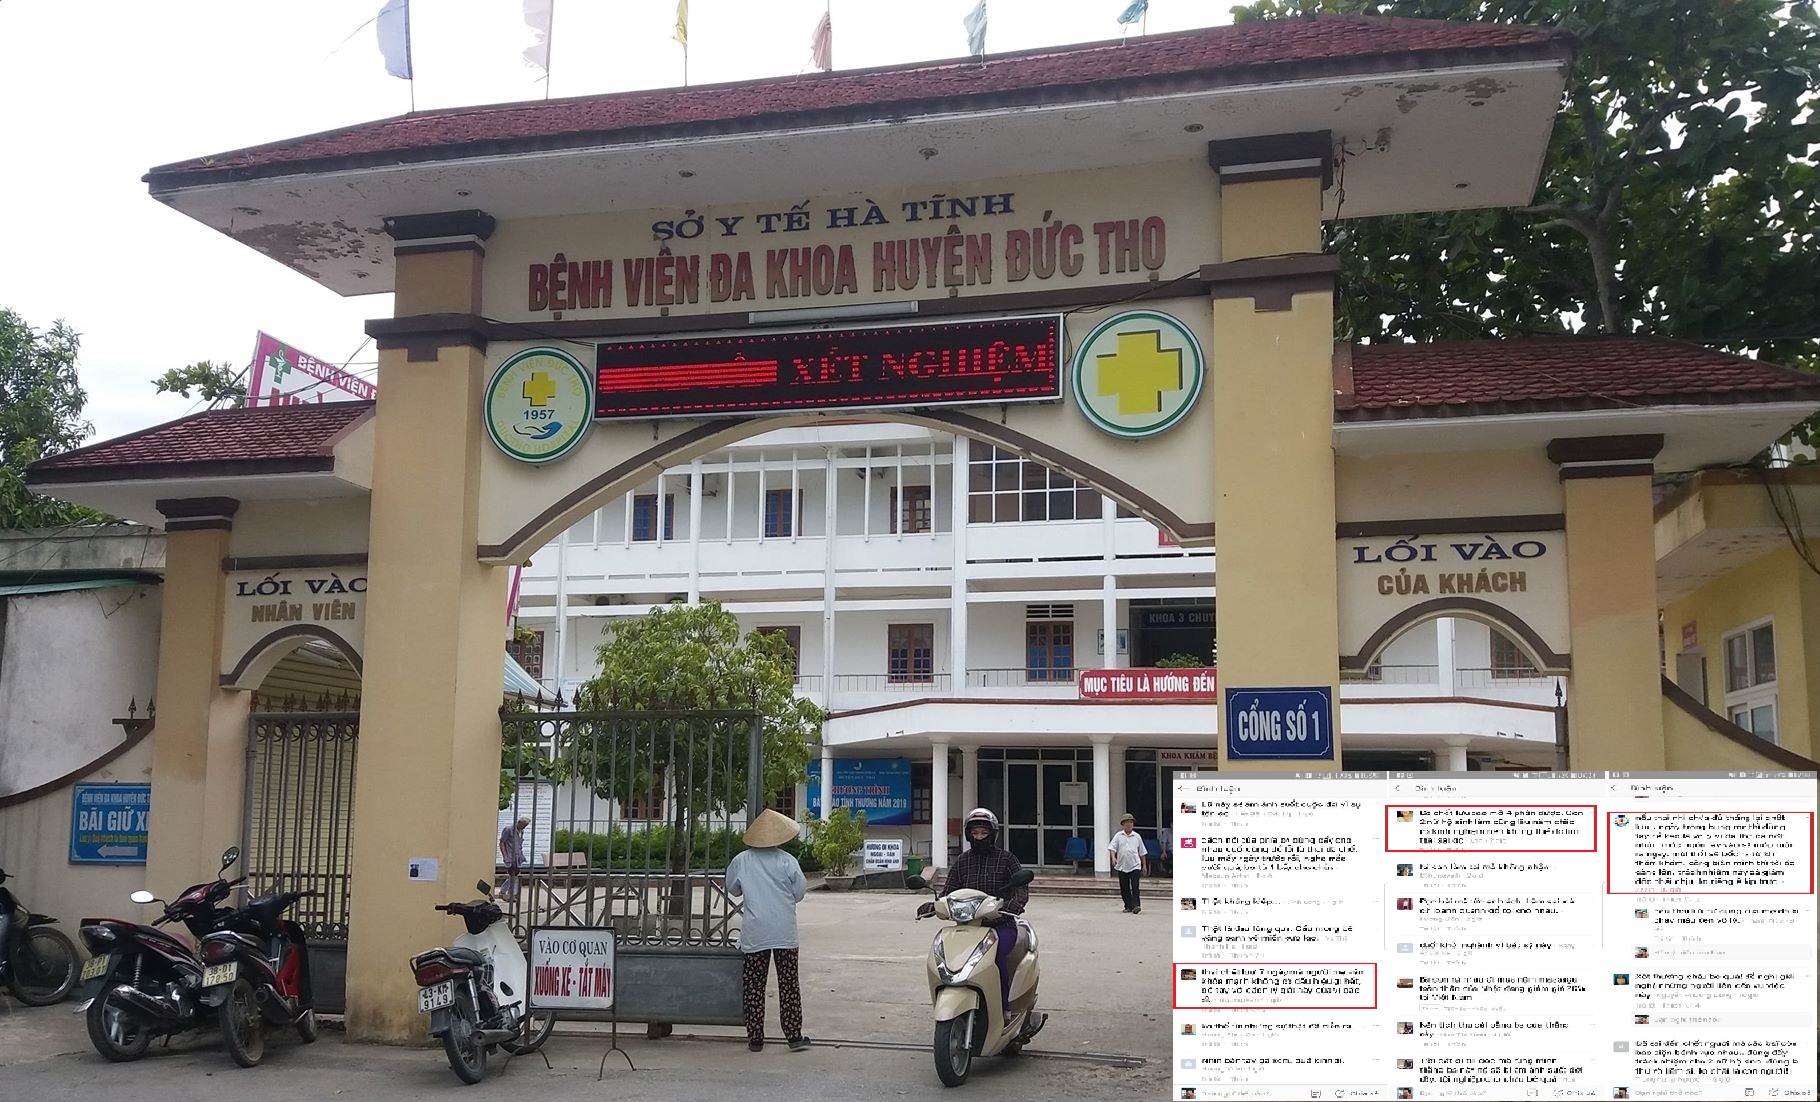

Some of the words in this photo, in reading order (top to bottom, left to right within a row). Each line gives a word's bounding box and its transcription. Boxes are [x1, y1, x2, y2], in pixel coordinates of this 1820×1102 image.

[652, 209, 704, 241] SỞ
[715, 216, 744, 237] Y
[756, 200, 810, 233] TẾ
[826, 198, 889, 229] HÀ
[902, 193, 1015, 222] TĨNH
[528, 253, 612, 320] BỆNH
[623, 247, 699, 316] VIỆN
[709, 251, 755, 302] ĐA
[766, 244, 858, 299] KHOA
[873, 224, 992, 298] HUYỆN
[1006, 210, 1084, 282] ĐỨC
[1093, 216, 1166, 281] THỌ
[298, 355, 335, 384] BỆNH
[338, 373, 368, 397] VIỆN
[523, 409, 555, 420] 1957
[1353, 535, 1437, 563] LỐI
[1450, 535, 1547, 560] VÀO
[236, 572, 292, 596] LỐI
[1378, 567, 1430, 595] CỦA
[1439, 567, 1527, 594] KHÁCH
[251, 600, 302, 622] NHÂN
[312, 599, 356, 620] VIÊN
[1149, 613, 1175, 623] KHOA
[1178, 613, 1184, 623] 3
[1084, 677, 1107, 696] MỤC
[1110, 673, 1133, 692] TIÊU
[1137, 673, 1150, 692] LÀ
[1153, 672, 1189, 692] HƯỚNG
[1193, 671, 1215, 692] ĐẾN
[1238, 698, 1281, 741] CỔNG
[1286, 699, 1307, 741] SỐ
[1312, 710, 1320, 741] 1
[1161, 752, 1182, 760] KHOA
[1184, 751, 1206, 760] KHÁM
[832, 784, 862, 795] HƯƠNG
[841, 796, 854, 808] TÌNH
[855, 798, 877, 808] THƯƠNG
[878, 796, 891, 808] NĂM
[892, 798, 907, 809] 2019
[79, 807, 103, 831] BÃI
[107, 806, 134, 832] GIỮ
[539, 937, 560, 954] VÀO
[562, 940, 577, 954] CƠ
[578, 941, 608, 957] QUAN
[534, 958, 560, 996] XUỐNG
[579, 958, 593, 997] TẮT
[594, 962, 611, 998] MÁY
